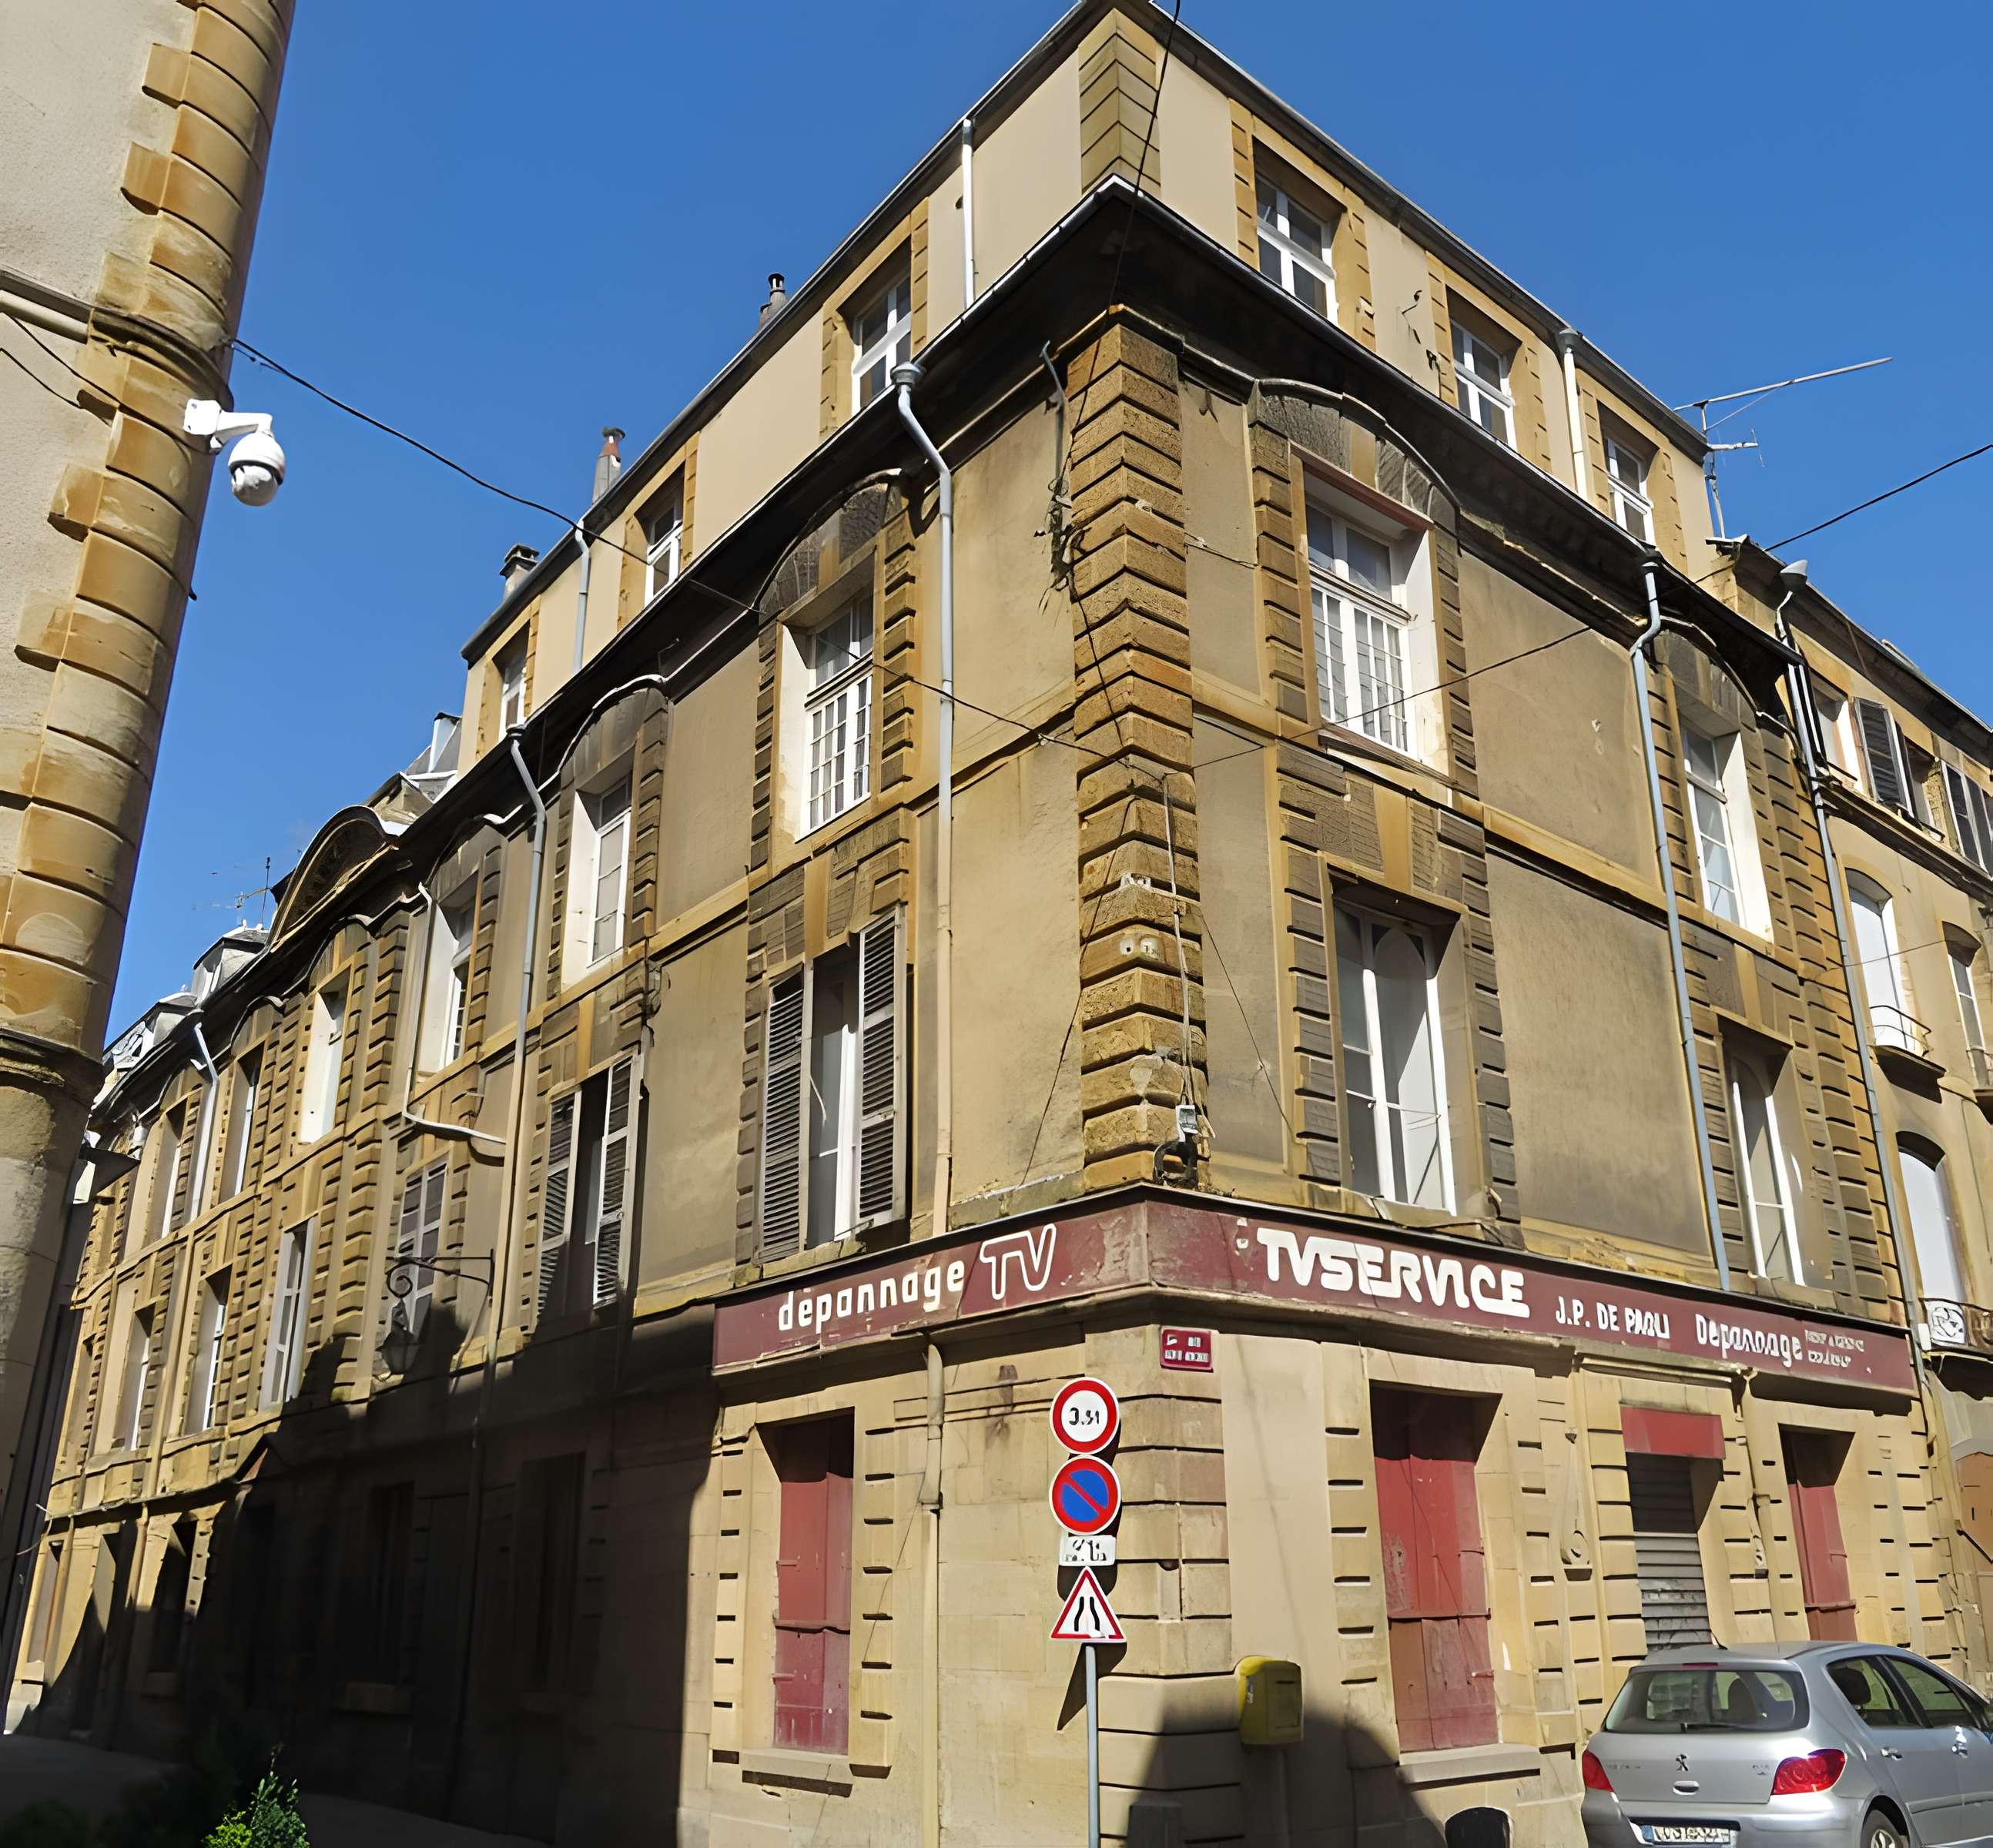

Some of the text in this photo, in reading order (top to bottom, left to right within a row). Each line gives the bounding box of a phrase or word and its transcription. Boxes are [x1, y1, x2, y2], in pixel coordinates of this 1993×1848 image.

[979, 1223, 1057, 1301] TV
[1555, 1296, 1591, 1328] J.P.
[1596, 1301, 1620, 1331] DE
